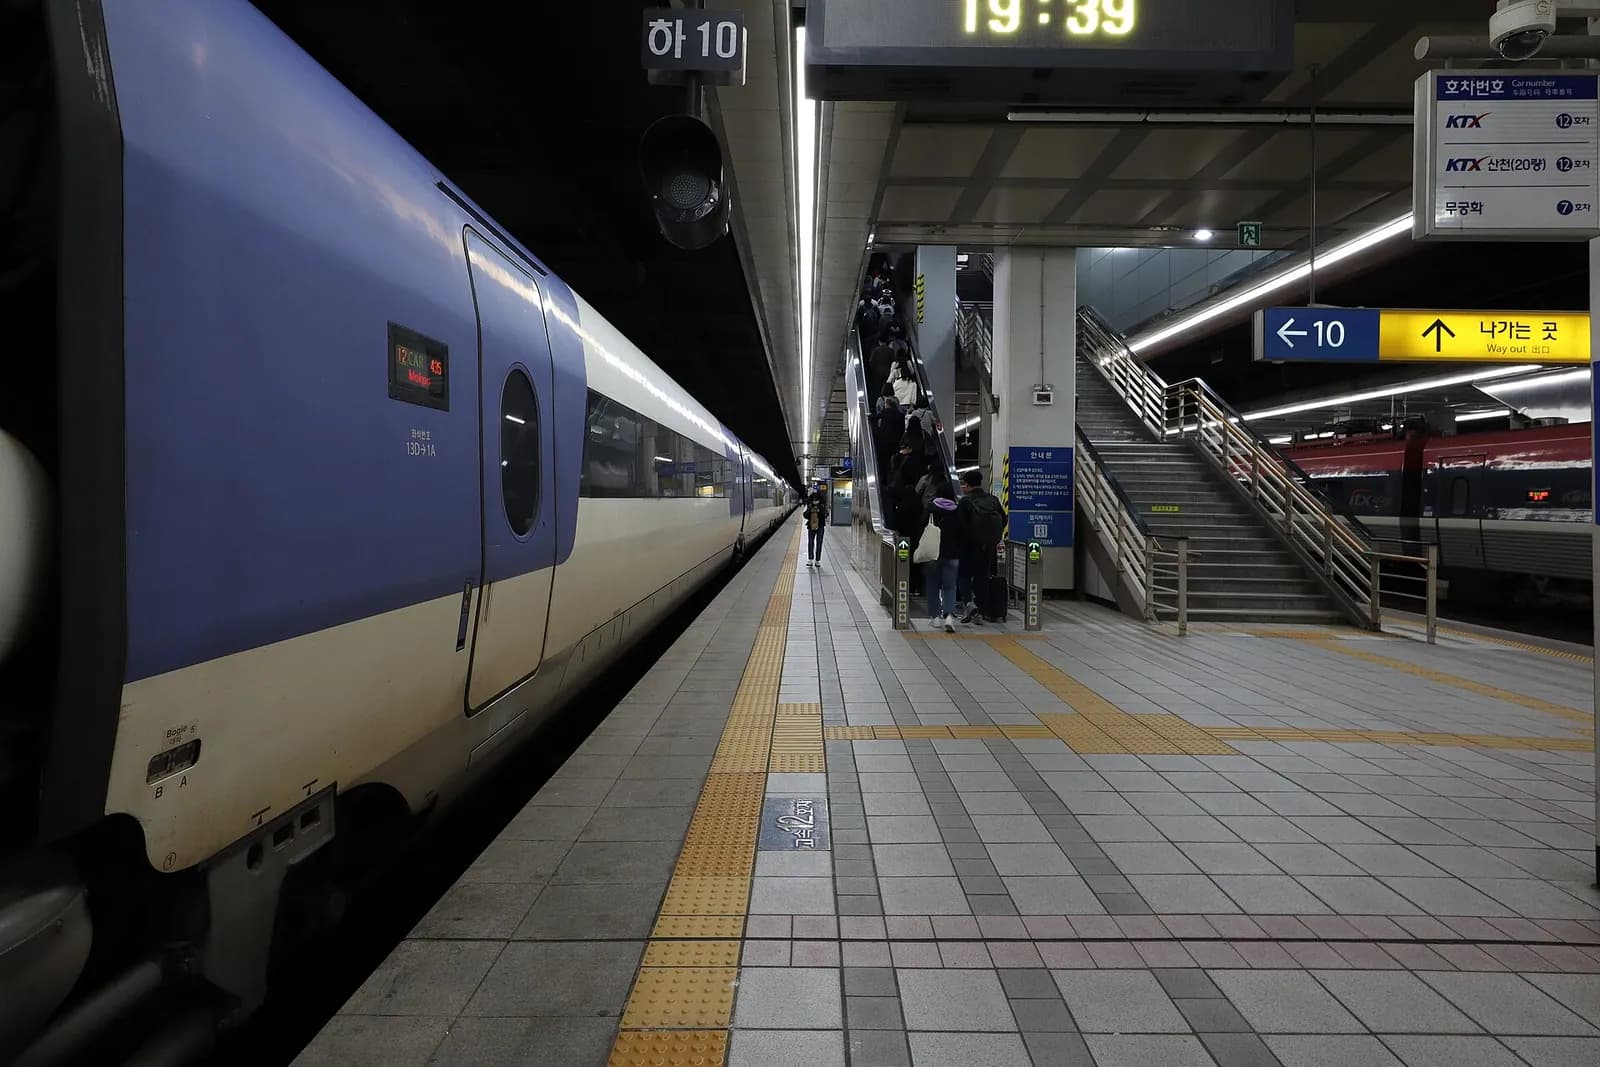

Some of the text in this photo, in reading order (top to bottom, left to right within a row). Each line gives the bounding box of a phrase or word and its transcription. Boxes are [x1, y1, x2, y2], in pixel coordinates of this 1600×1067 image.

[648, 18, 737, 58] 하 10
[1445, 80, 1505, 96] 호차번호
[1511, 79, 1556, 88] Car number
[1445, 112, 1492, 128] KTX
[1557, 115, 1590, 127] 12 호차
[1445, 156, 1546, 172] KTX 산천(20량)
[1557, 159, 1590, 171] 12 호차
[1445, 201, 1484, 216] 무궁화
[1574, 203, 1591, 212] 호차
[1312, 320, 1345, 348] 10
[1480, 320, 1558, 341] 나가는 곳
[1486, 343, 1527, 355] Way out
[1531, 345, 1550, 354] 出口
[154, 775, 188, 799] B A
[776, 815, 815, 832] 12
